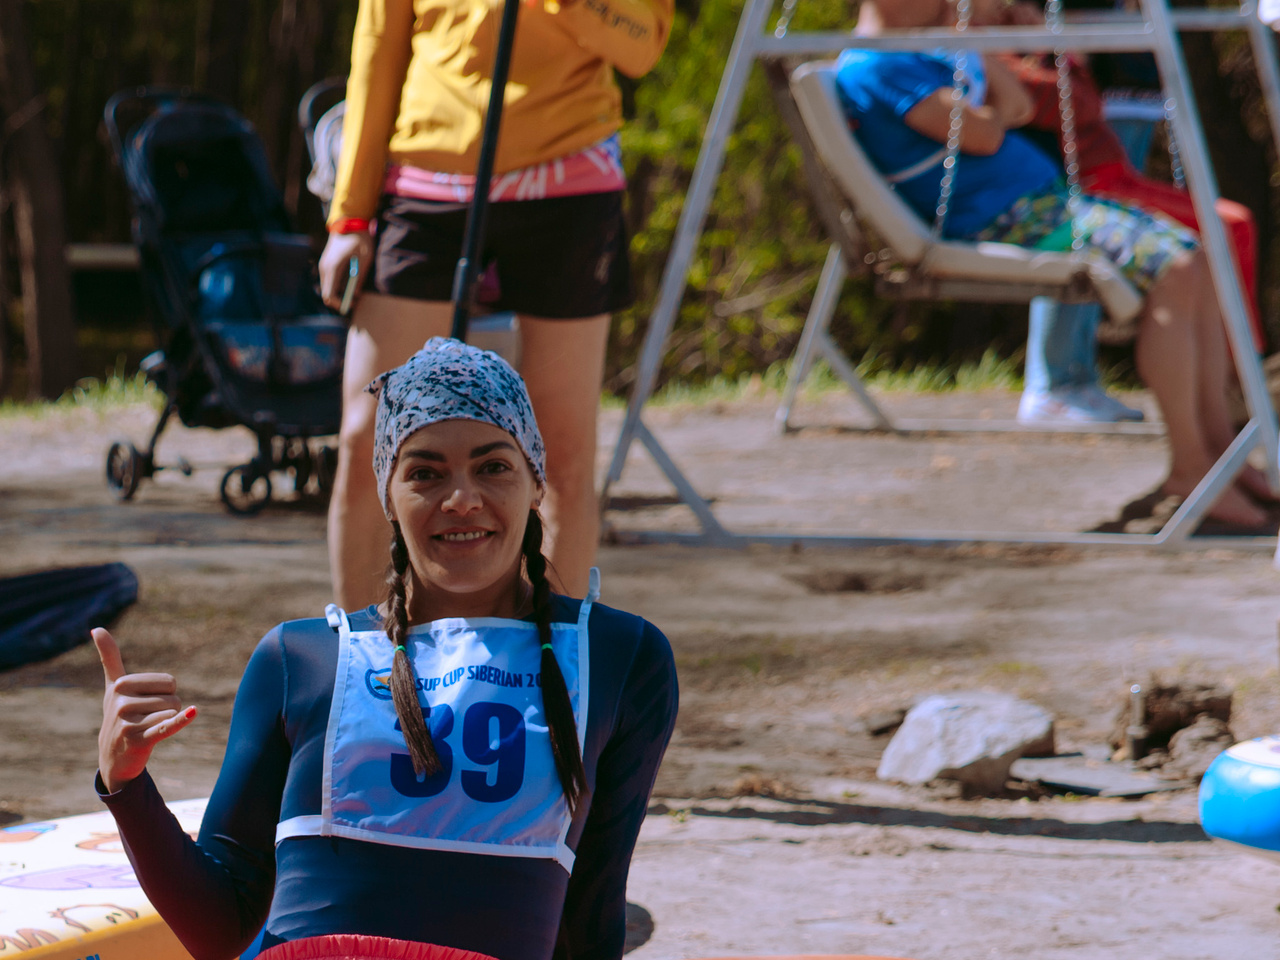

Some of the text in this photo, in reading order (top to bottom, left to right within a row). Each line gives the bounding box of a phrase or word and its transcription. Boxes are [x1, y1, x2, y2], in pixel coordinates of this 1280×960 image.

[415, 676, 442, 692] SUP
[442, 667, 465, 688] CUP
[466, 664, 523, 688] SIBERIAN
[389, 701, 527, 804] 39
